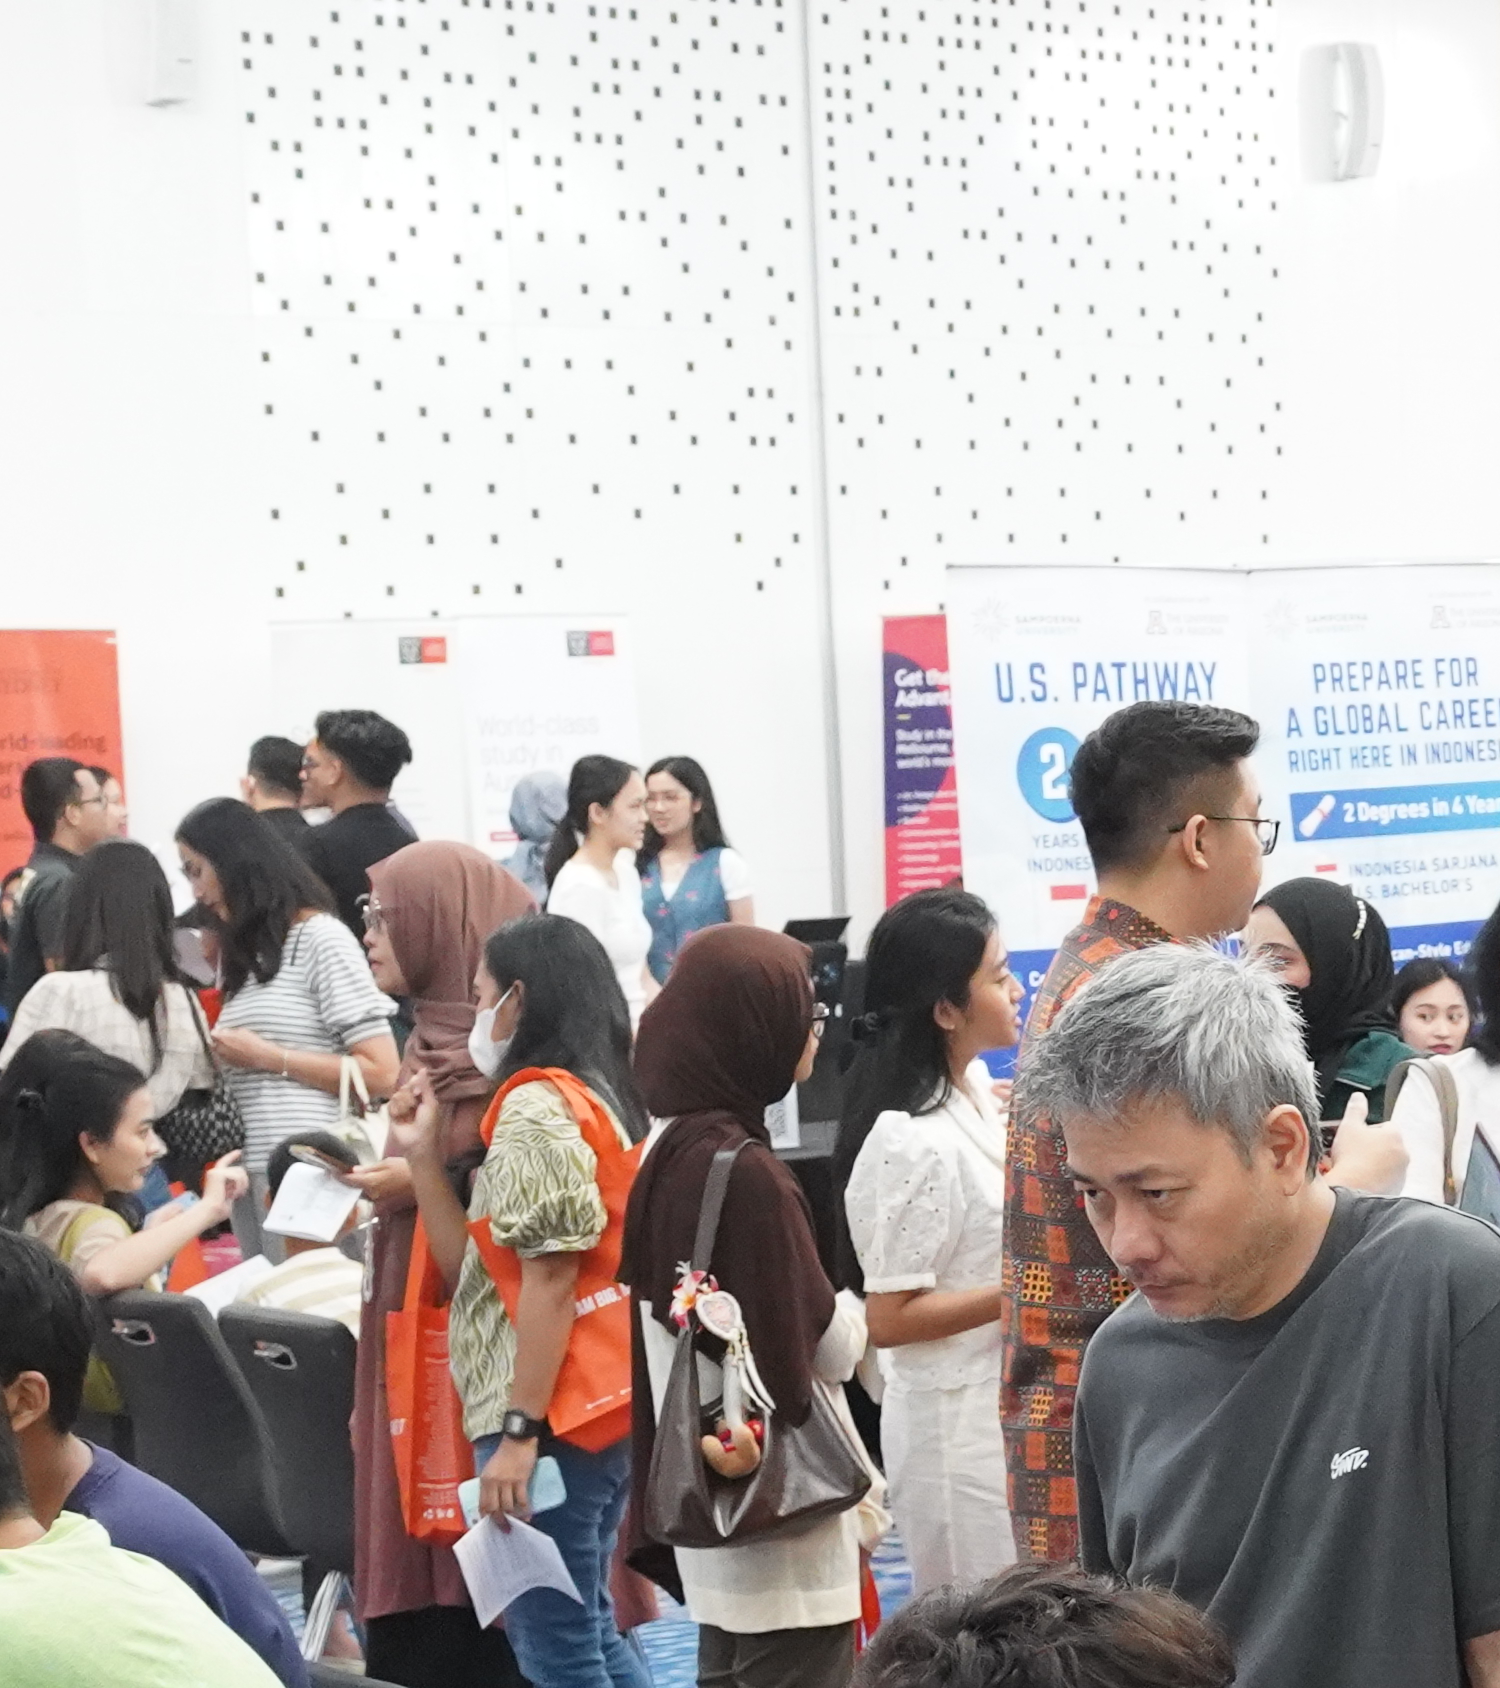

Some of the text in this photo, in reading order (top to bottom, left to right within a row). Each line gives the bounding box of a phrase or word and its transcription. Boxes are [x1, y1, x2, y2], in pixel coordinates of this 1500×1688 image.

[1015, 614, 1081, 625] SAMPOERNA
[1306, 613, 1368, 623] SAMPOERNA
[894, 668, 923, 688] Get
[995, 661, 1217, 703] U.S. PATHWAY
[1312, 657, 1479, 694] PREPARE FOR
[475, 712, 600, 737] World-class
[1287, 707, 1303, 738] A
[1313, 702, 1408, 736] GLOBAL
[481, 741, 564, 767] study in
[1288, 748, 1342, 773] RIGHT
[1350, 745, 1393, 770] HERE
[1400, 743, 1418, 766] IN
[1039, 742, 1068, 800] 2
[1343, 802, 1356, 823] 2
[1357, 801, 1430, 826] Degrees
[1432, 797, 1450, 817] in
[1451, 796, 1464, 815] 4
[1032, 833, 1080, 850] YEARS
[1027, 857, 1092, 873] INDONES
[1349, 858, 1427, 878] INDONESIA
[1432, 854, 1498, 872] SARJANA
[1382, 878, 1473, 899] BACHELOR'S
[1391, 942, 1452, 962] can-Style
